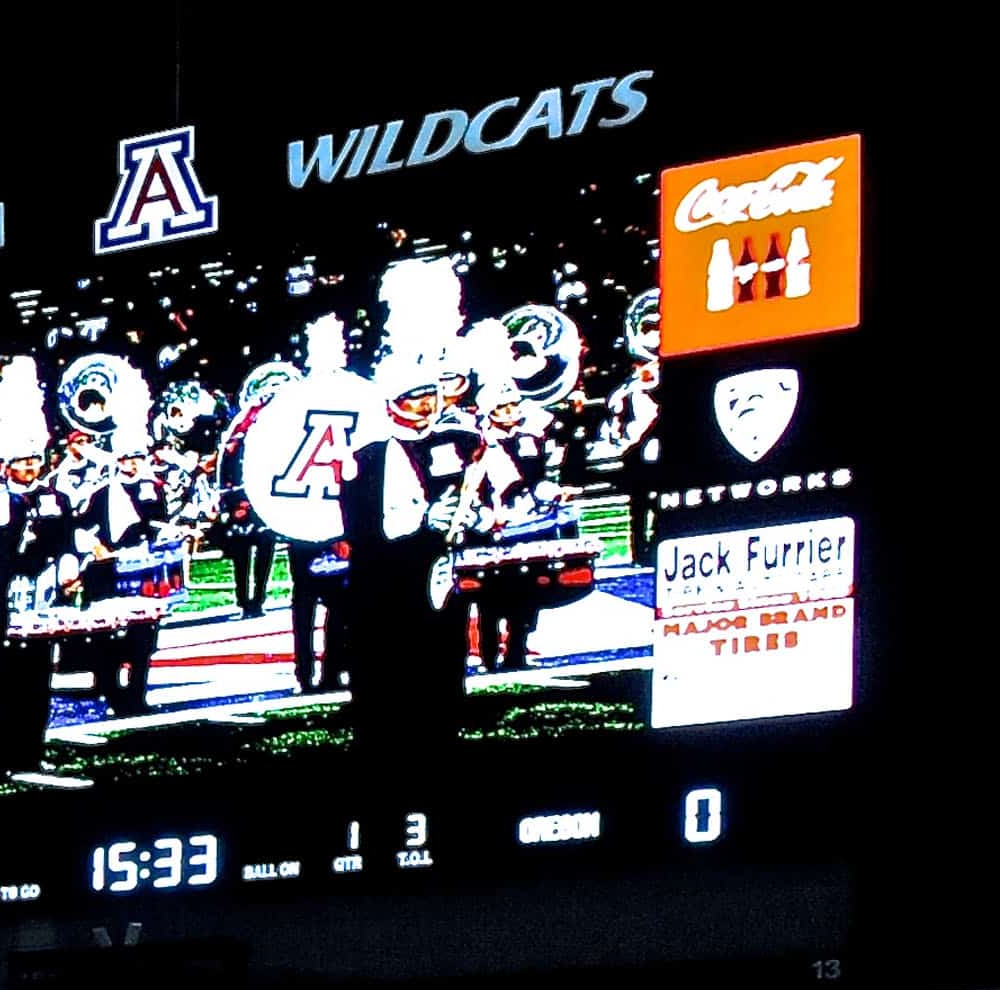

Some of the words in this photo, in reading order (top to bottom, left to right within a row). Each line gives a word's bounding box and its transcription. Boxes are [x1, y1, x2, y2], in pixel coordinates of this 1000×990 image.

[287, 70, 654, 189] WILDCATS
[94, 126, 219, 254] A
[660, 468, 853, 510] NETWORKS
[664, 540, 731, 582] Jack
[747, 528, 846, 572] Furrier
[663, 615, 747, 637] MAJOR
[760, 604, 846, 627] BRAND
[710, 631, 799, 656] TIRES
[406, 813, 426, 846] 3
[685, 788, 721, 843] 0
[92, 834, 218, 892] 15:33
[812, 959, 841, 979] 13
